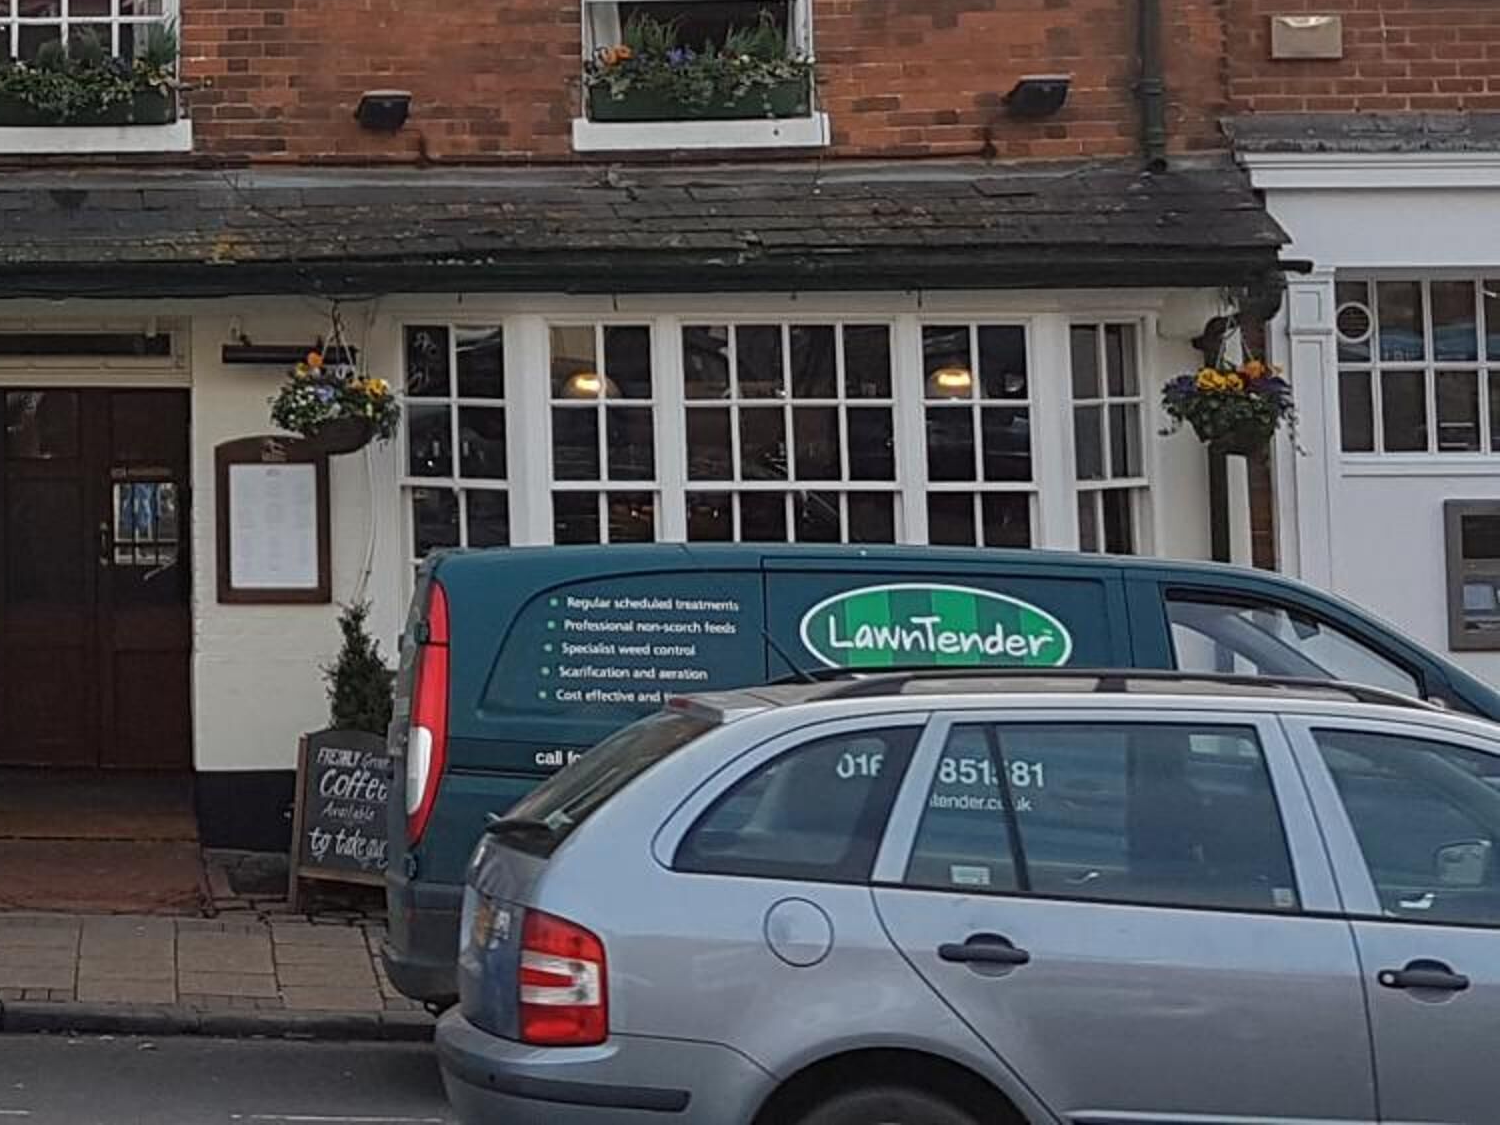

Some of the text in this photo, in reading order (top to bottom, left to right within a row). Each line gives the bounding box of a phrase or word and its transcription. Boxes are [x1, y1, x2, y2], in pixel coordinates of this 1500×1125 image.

[566, 596, 739, 612] Regular scheduled treatments
[563, 619, 737, 635] Professional non-scorch feeds
[828, 614, 1054, 657] LawnTender
[561, 642, 696, 656] Specialist weed control
[558, 665, 708, 681] Scarification and aeration
[555, 689, 582, 701] Cost
[585, 689, 635, 702] effective
[638, 690, 661, 702] and
[535, 750, 563, 765] call
